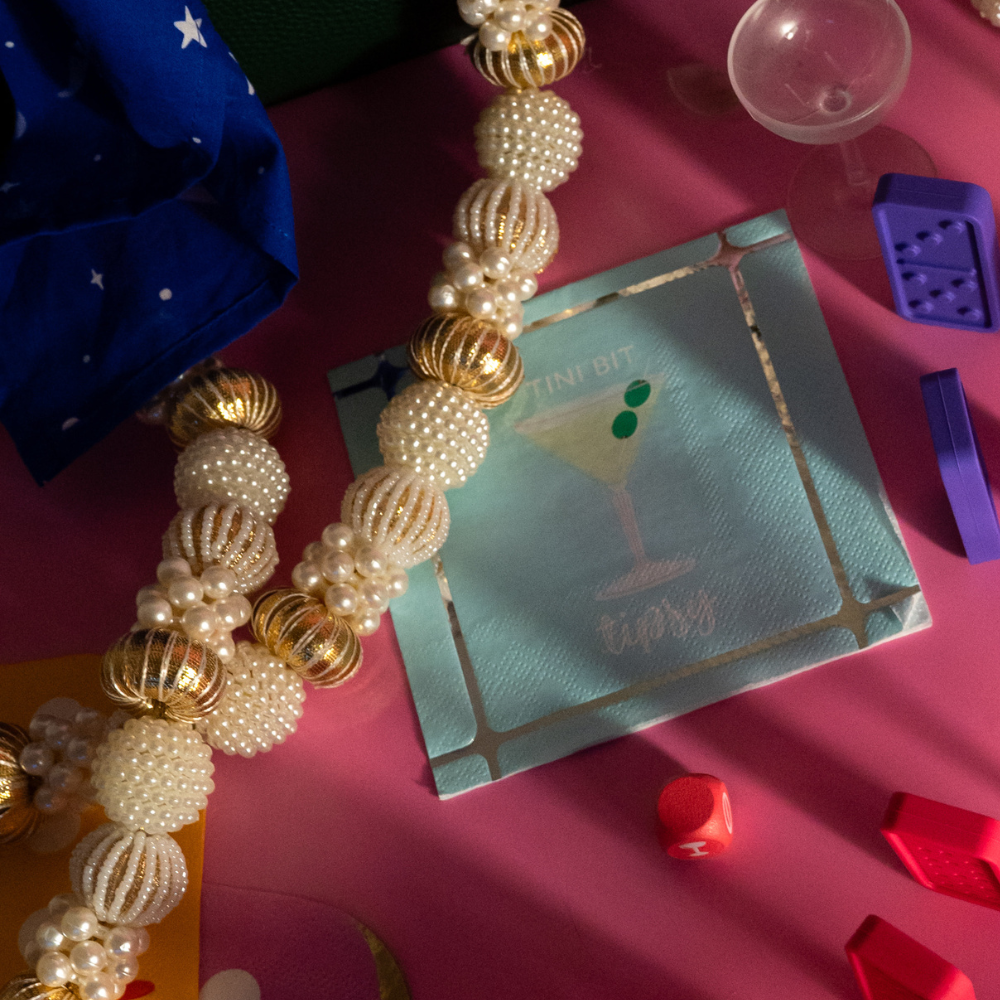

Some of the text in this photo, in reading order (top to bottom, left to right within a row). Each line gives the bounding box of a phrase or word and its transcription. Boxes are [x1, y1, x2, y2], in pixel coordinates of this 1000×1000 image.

[525, 345, 635, 399] TINI BIT
[596, 589, 718, 655] tipsy
